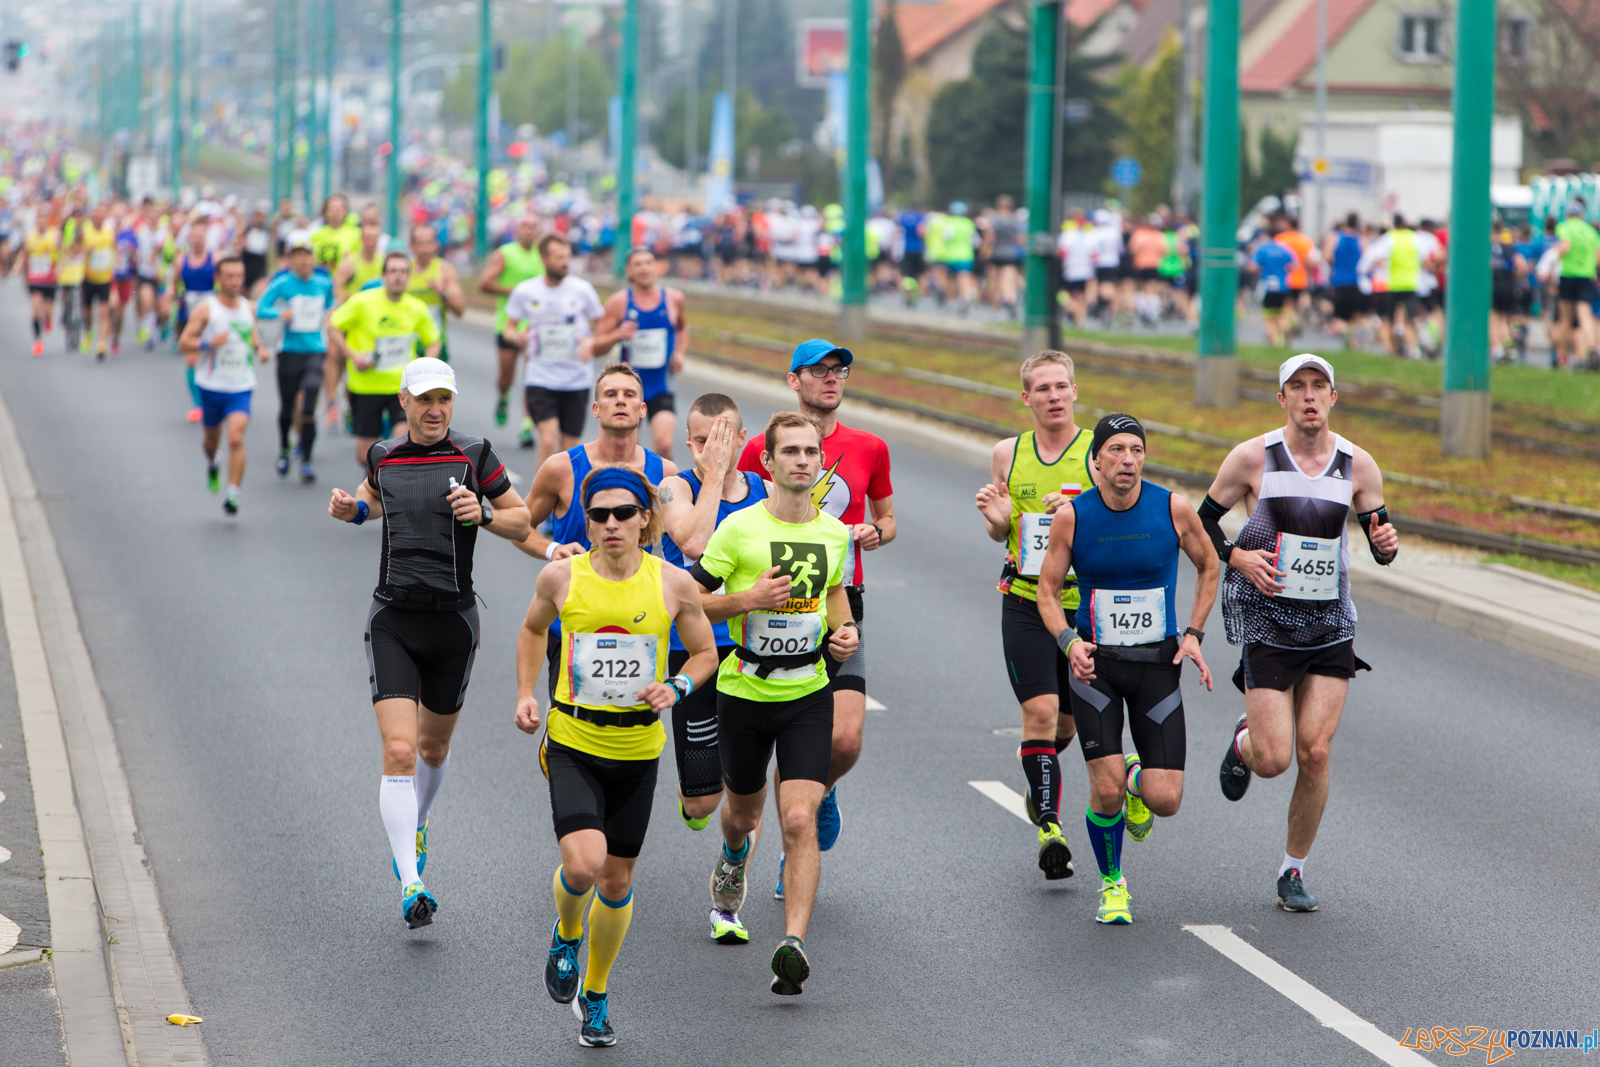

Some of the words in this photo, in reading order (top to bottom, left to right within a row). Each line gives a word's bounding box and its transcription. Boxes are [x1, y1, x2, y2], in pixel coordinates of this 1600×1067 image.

[1291, 558, 1335, 576] 4655
[1109, 612, 1153, 629] 1478
[758, 635, 809, 654] 7002
[591, 659, 641, 678] 2122
